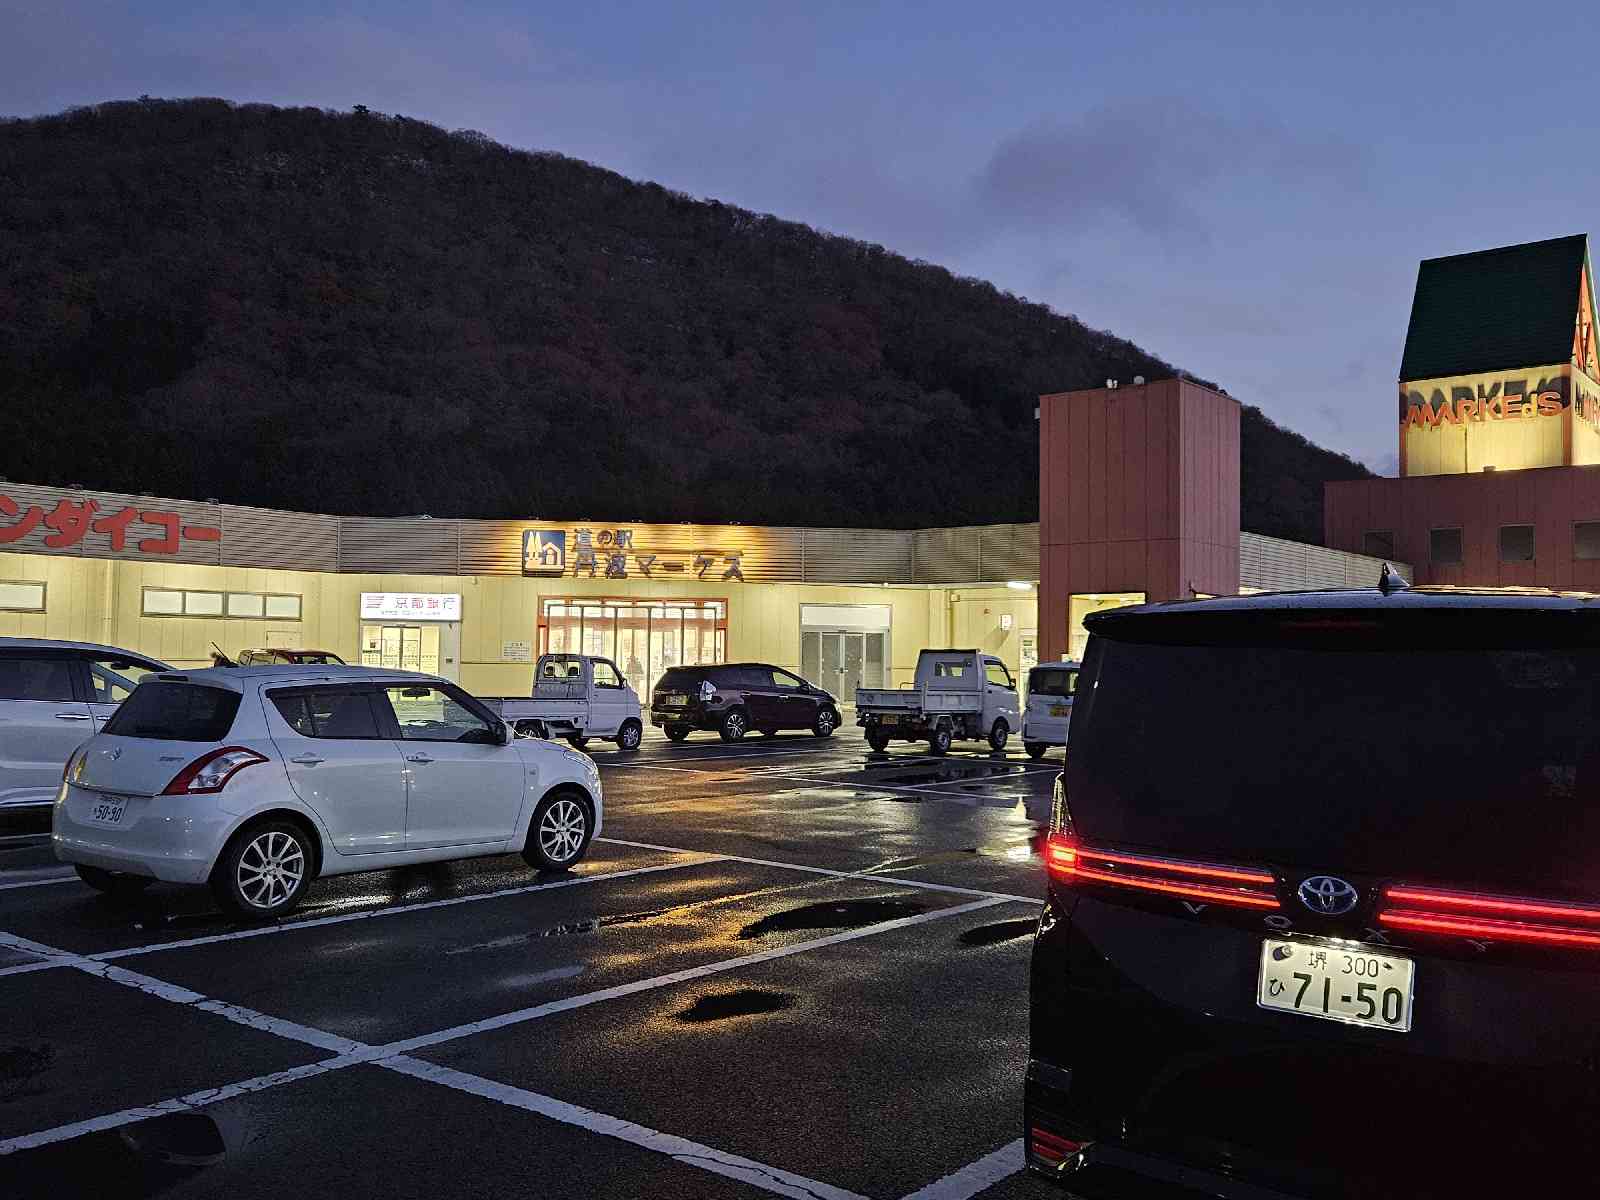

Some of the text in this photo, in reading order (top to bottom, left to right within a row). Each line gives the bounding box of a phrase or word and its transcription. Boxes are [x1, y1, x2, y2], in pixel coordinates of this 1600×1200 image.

[571, 527, 633, 549] 道の駅
[1307, 951, 1379, 978] 堺 300
[1269, 971, 1404, 1025] ひ 71-50
